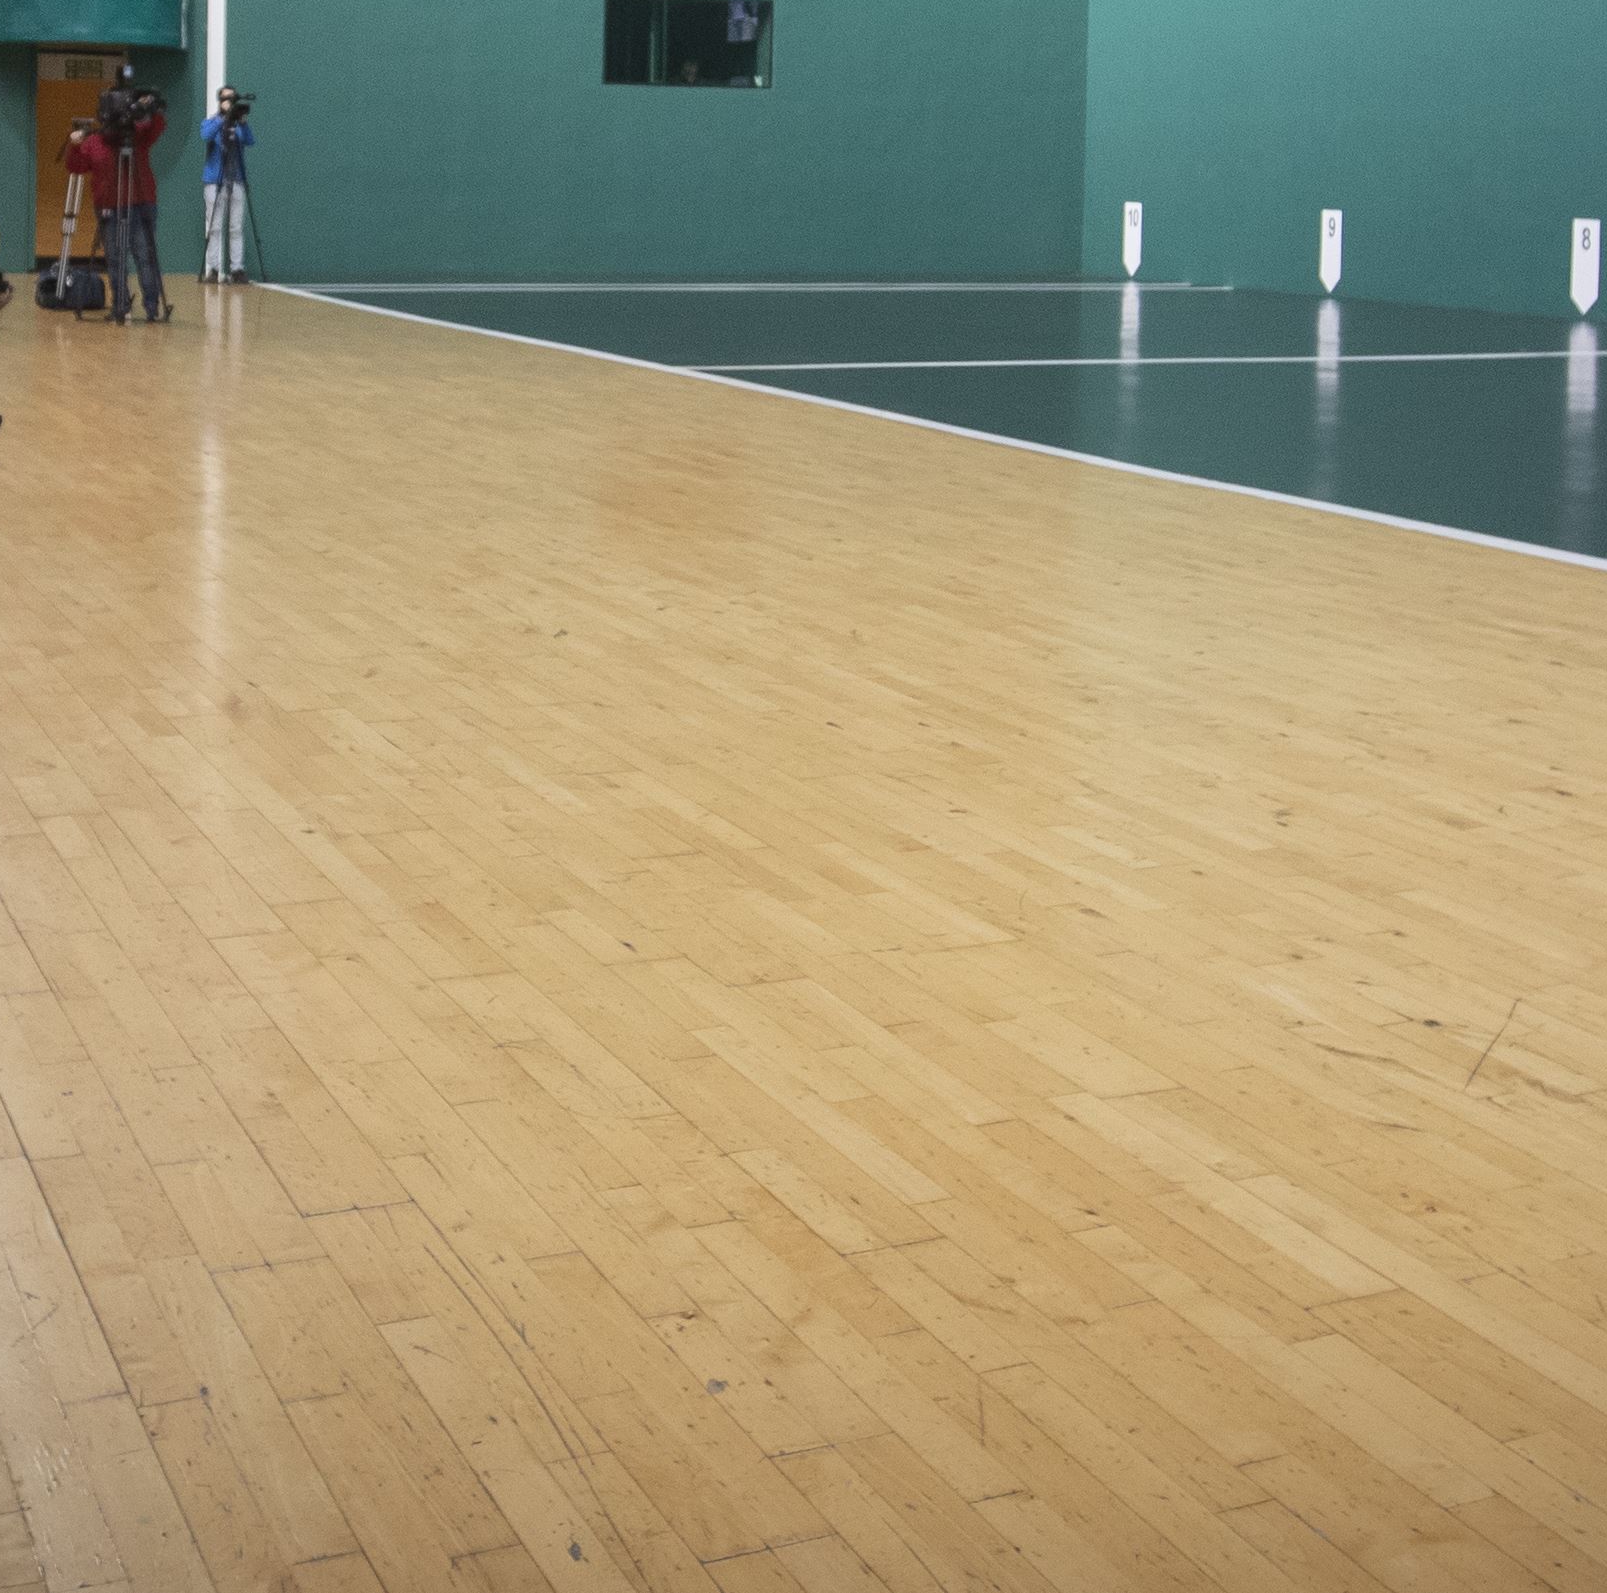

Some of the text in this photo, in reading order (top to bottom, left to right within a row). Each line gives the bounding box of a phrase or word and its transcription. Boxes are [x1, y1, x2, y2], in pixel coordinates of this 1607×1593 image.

[1128, 209, 1139, 227] 10
[1328, 217, 1337, 238] 9
[1581, 227, 1592, 251] 8
